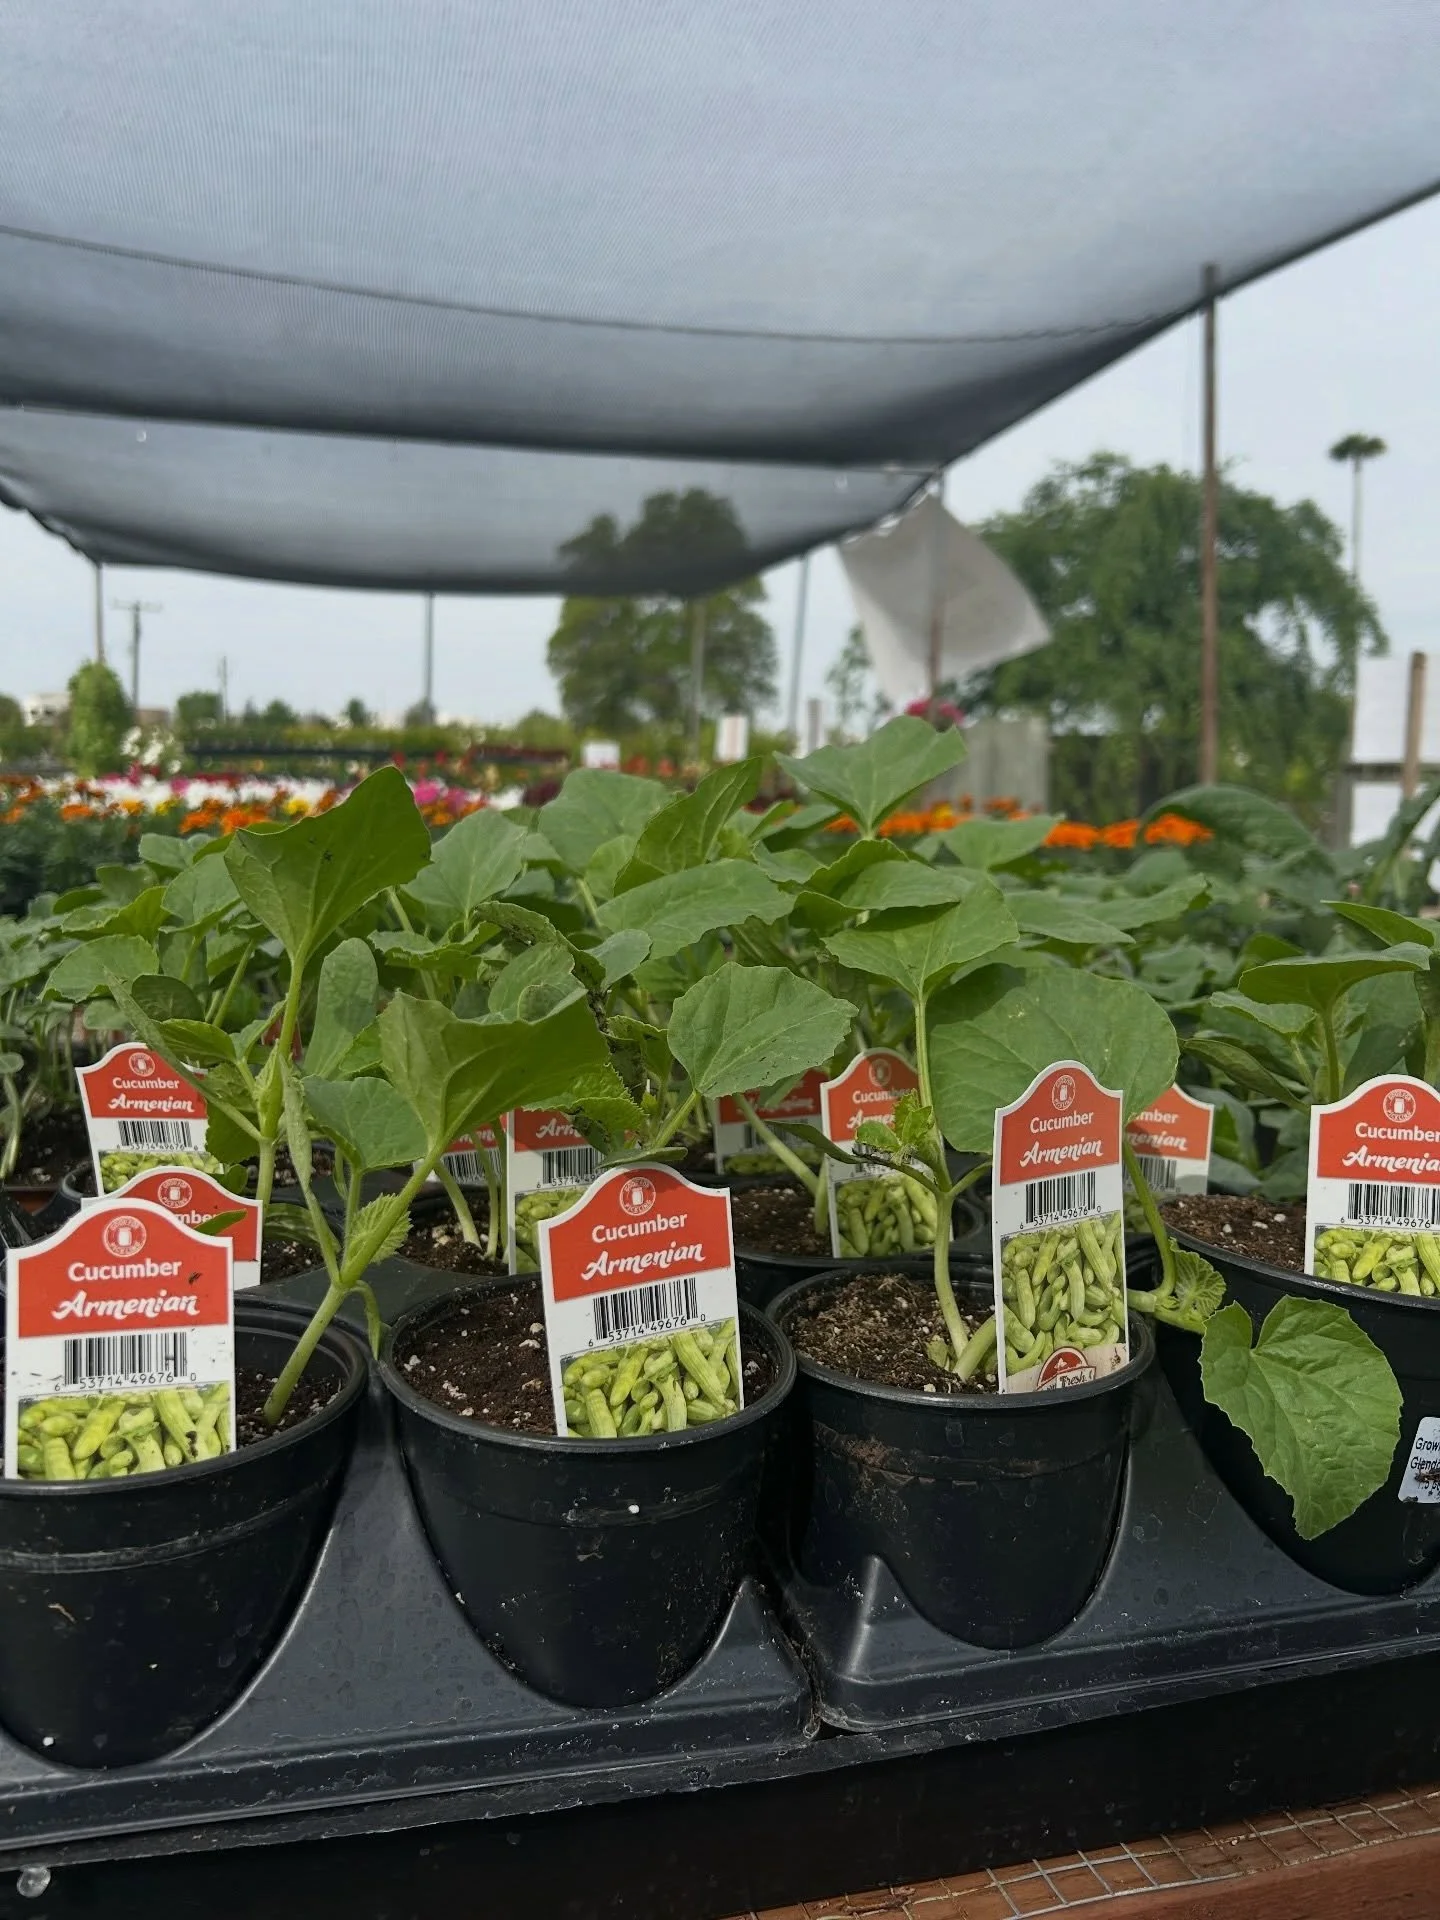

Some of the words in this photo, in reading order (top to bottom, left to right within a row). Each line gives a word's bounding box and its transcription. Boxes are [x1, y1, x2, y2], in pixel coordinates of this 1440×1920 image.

[112, 1076, 180, 1089] Cucumber
[108, 1094, 195, 1113] Armenian
[1030, 1110, 1094, 1135] Cucumber
[1020, 1137, 1103, 1168] Armenian
[1341, 1145, 1440, 1175] Armenia
[591, 1212, 688, 1243] Cucumber
[1033, 1213, 1059, 1227] 53714
[1062, 1206, 1088, 1219] 49676
[1358, 1215, 1391, 1225] 53714
[1396, 1218, 1431, 1228] 49676
[67, 1258, 182, 1281] Cucumber
[581, 1241, 706, 1280] Armenian
[51, 1290, 201, 1320] Armenian
[588, 1339, 594, 1347] 6
[608, 1327, 645, 1342] 53714
[650, 1317, 687, 1332] 49676
[80, 1373, 122, 1389] 53714
[130, 1369, 174, 1385] 49676
[1415, 1437, 1440, 1452] Grow
